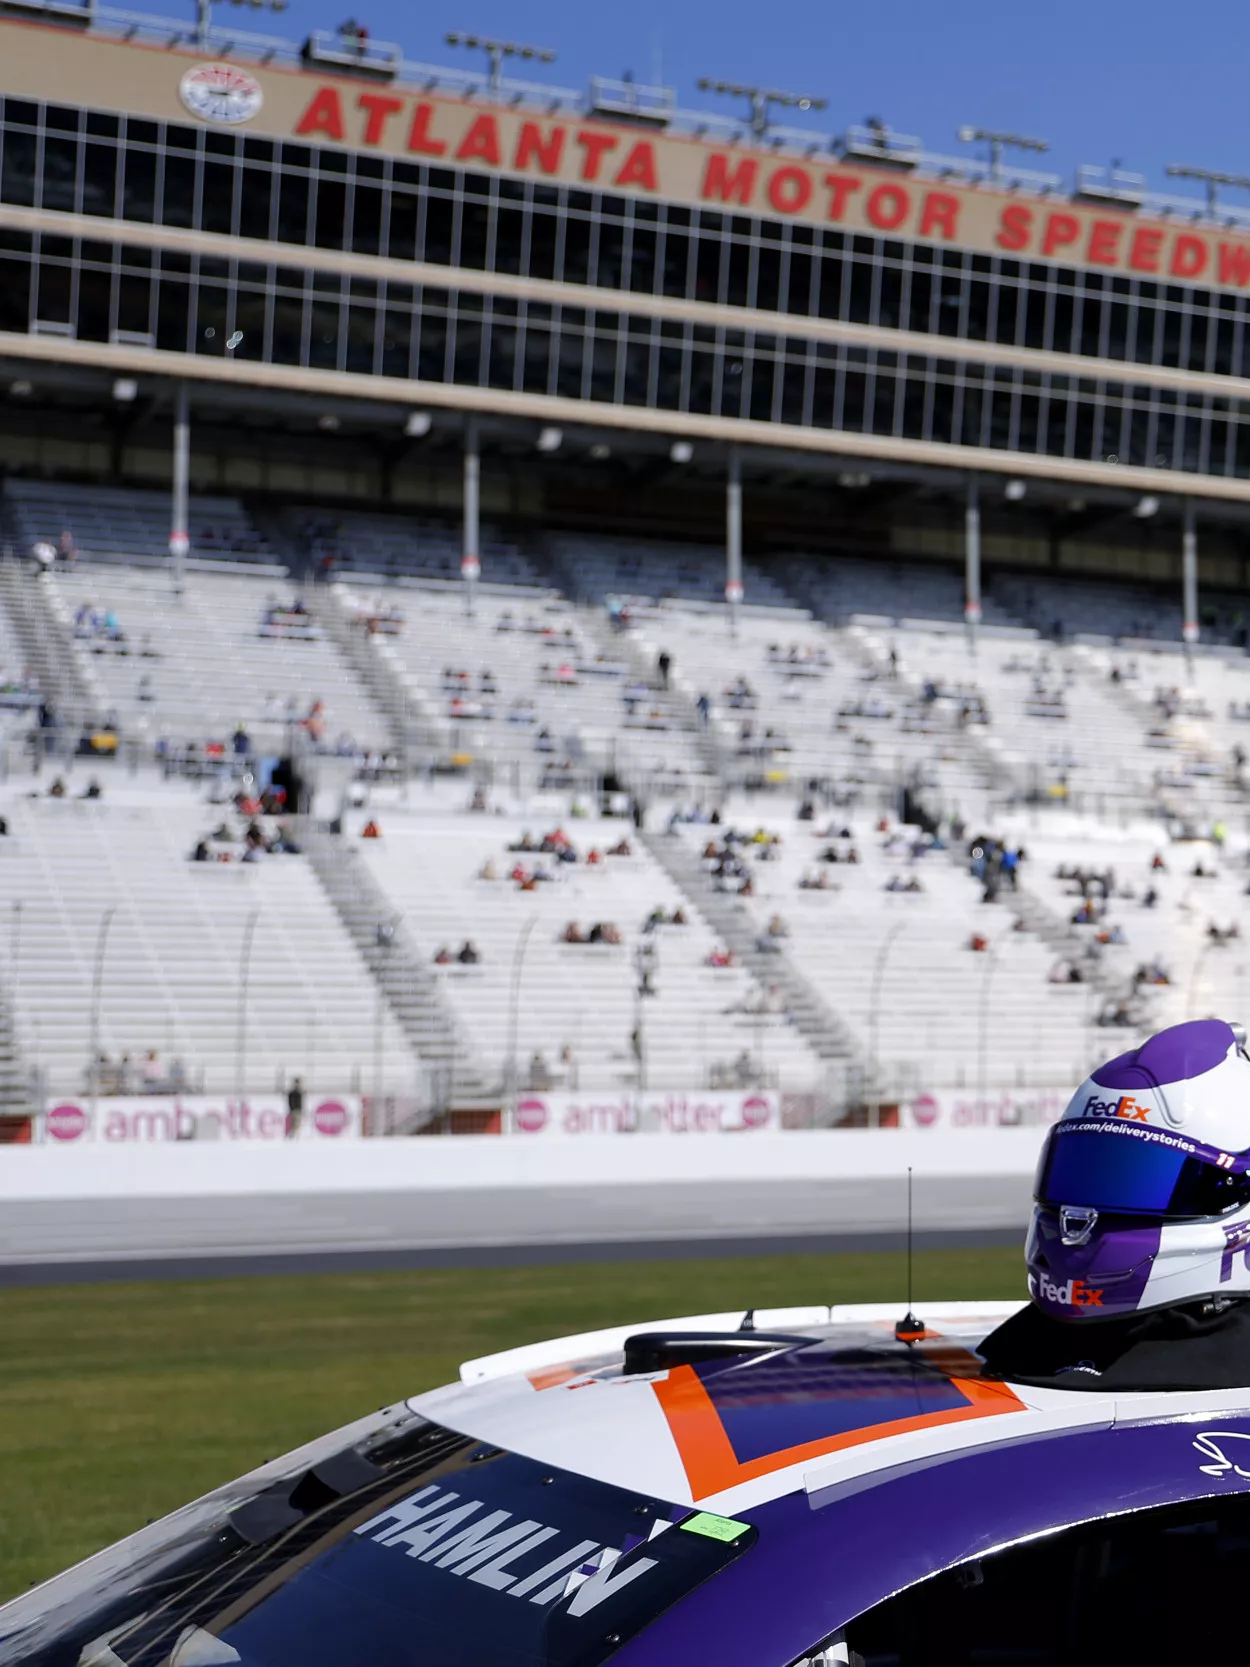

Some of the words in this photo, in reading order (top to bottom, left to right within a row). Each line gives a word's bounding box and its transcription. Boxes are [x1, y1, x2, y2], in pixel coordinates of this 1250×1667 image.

[296, 86, 659, 192] ATLANTA
[701, 152, 962, 240] MOTOR
[1082, 1095, 1153, 1123] FedEx
[1216, 1152, 1236, 1169] 11
[1039, 1273, 1104, 1307] FedEx
[352, 1484, 659, 1617] HAMLIN
